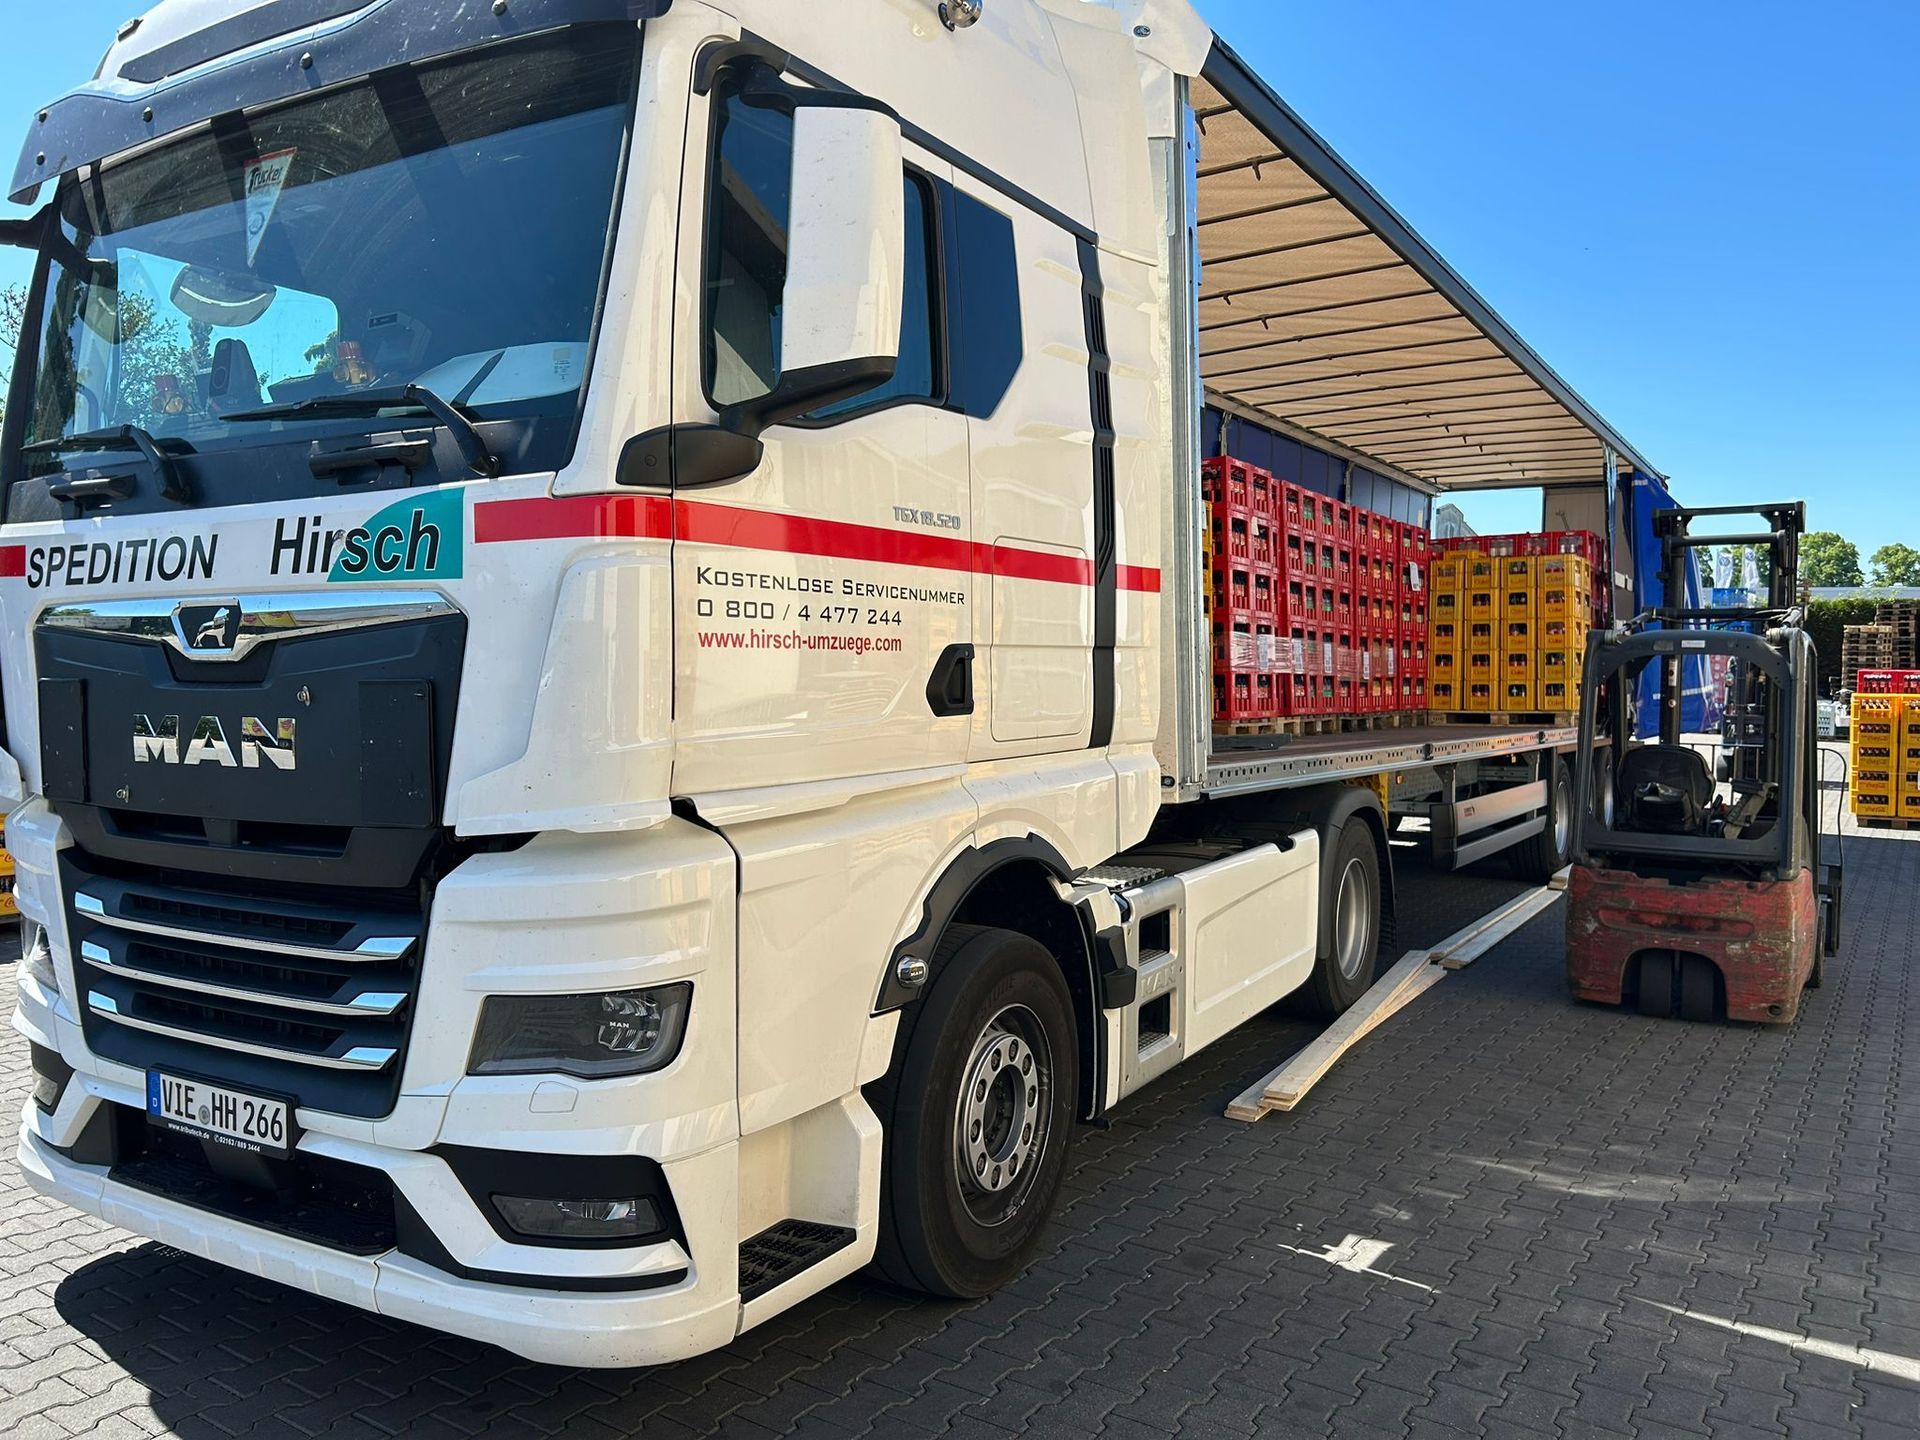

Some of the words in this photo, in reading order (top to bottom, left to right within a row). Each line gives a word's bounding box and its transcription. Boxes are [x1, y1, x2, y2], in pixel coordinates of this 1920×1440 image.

[893, 506, 919, 524] TGX
[920, 511, 961, 530] 18.520
[27, 533, 219, 588] SPEDITION
[270, 509, 440, 576] Hirsch
[726, 600, 774, 619] 800
[798, 604, 810, 621] 4
[820, 605, 859, 624] 477
[867, 608, 902, 626] 244
[698, 628, 902, 656] www.hirsch-umzuege.com
[132, 713, 296, 770] MAN
[609, 1021, 630, 1029] MAN
[152, 1097, 158, 1108] D
[162, 1078, 197, 1120] VIE
[211, 1092, 237, 1131] HH
[243, 1100, 284, 1142] 266
